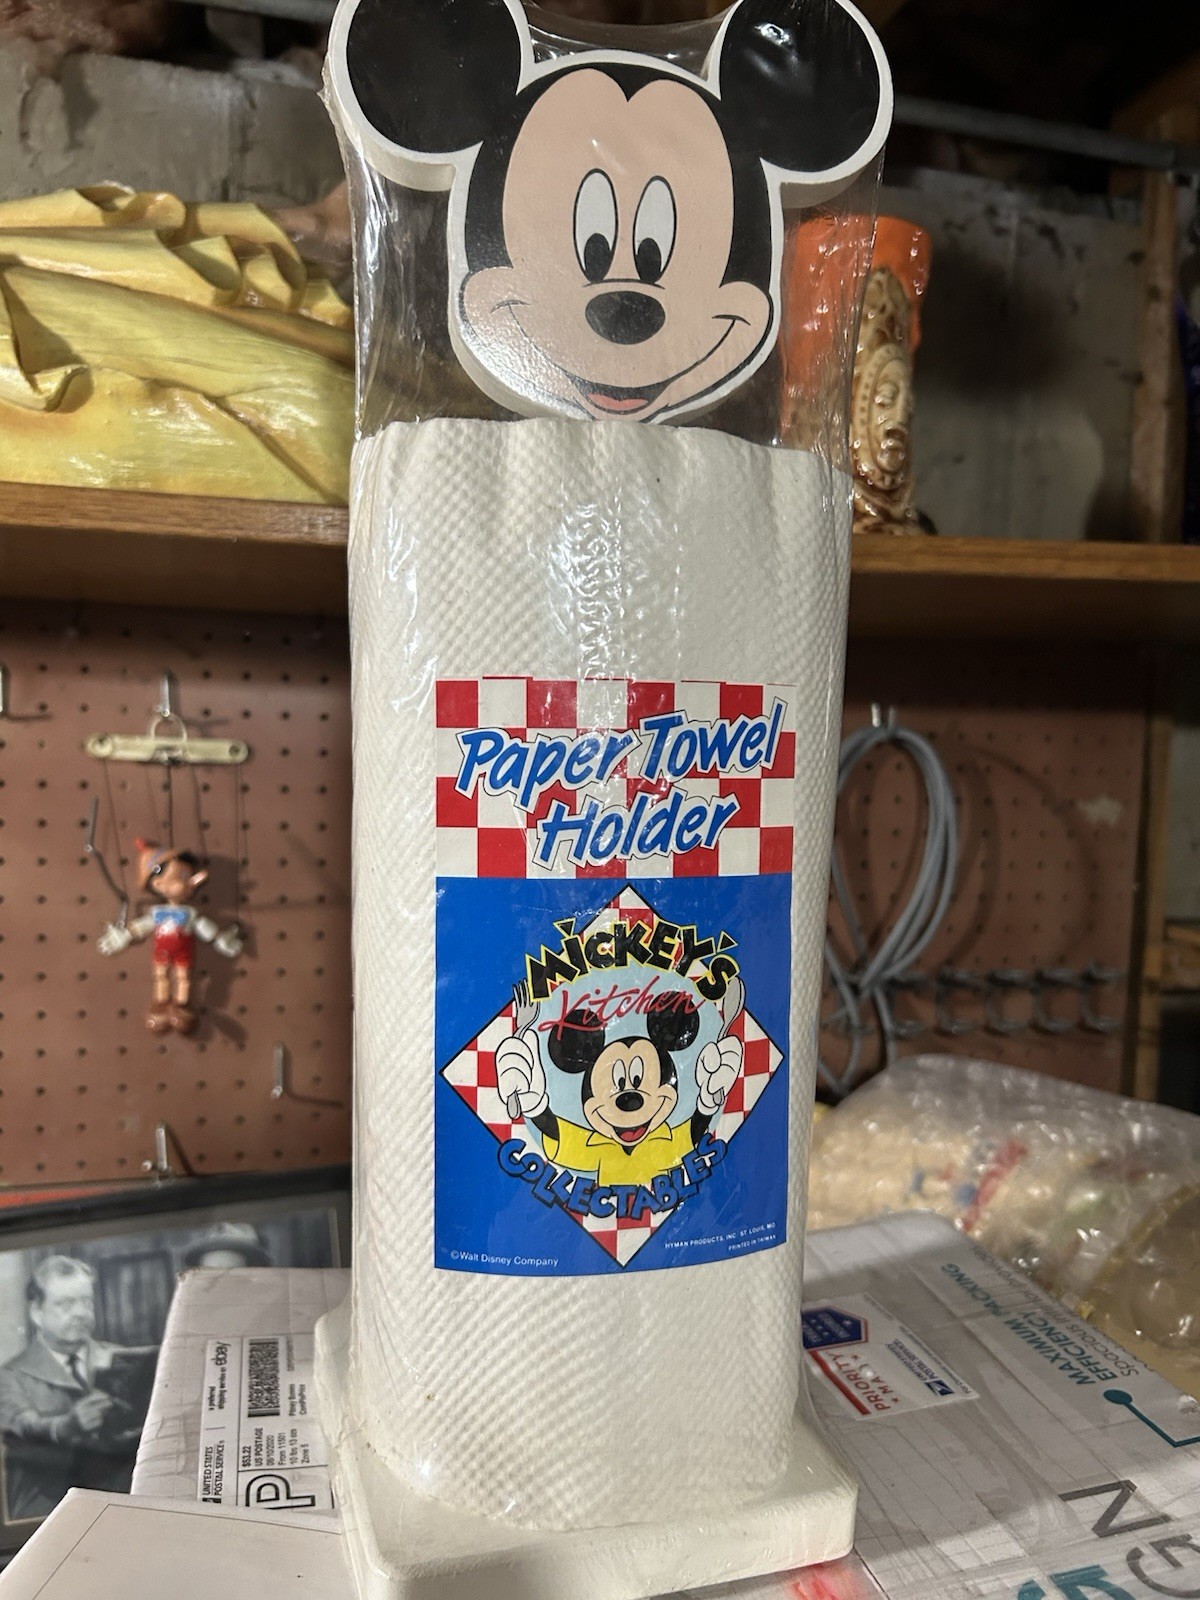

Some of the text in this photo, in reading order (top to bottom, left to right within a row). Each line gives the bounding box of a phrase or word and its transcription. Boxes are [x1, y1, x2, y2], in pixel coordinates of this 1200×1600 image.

[457, 698, 786, 812] Paper Towel
[534, 790, 739, 869] Holder
[538, 975, 706, 1041] Kitchen
[498, 1132, 728, 1220] COLLECTABLES
[481, 1253, 512, 1266] Disney
[513, 1255, 560, 1267] Company
[665, 1241, 689, 1249] HYMAN
[1004, 1317, 1097, 1386] MAXIMUM
[1021, 1311, 1119, 1382] EFFICIENCY
[1066, 1324, 1140, 1378] Spacious
[828, 1351, 891, 1412] PRIORITY
[202, 1446, 213, 1496] UNITED STATES
[242, 1445, 252, 1467] $53.22
[254, 1427, 264, 1467] US POSTAGE
[277, 1449, 287, 1466] From
[301, 1448, 310, 1464] Zone
[214, 1470, 224, 1496] POSTAL
[245, 1473, 316, 1510] P
